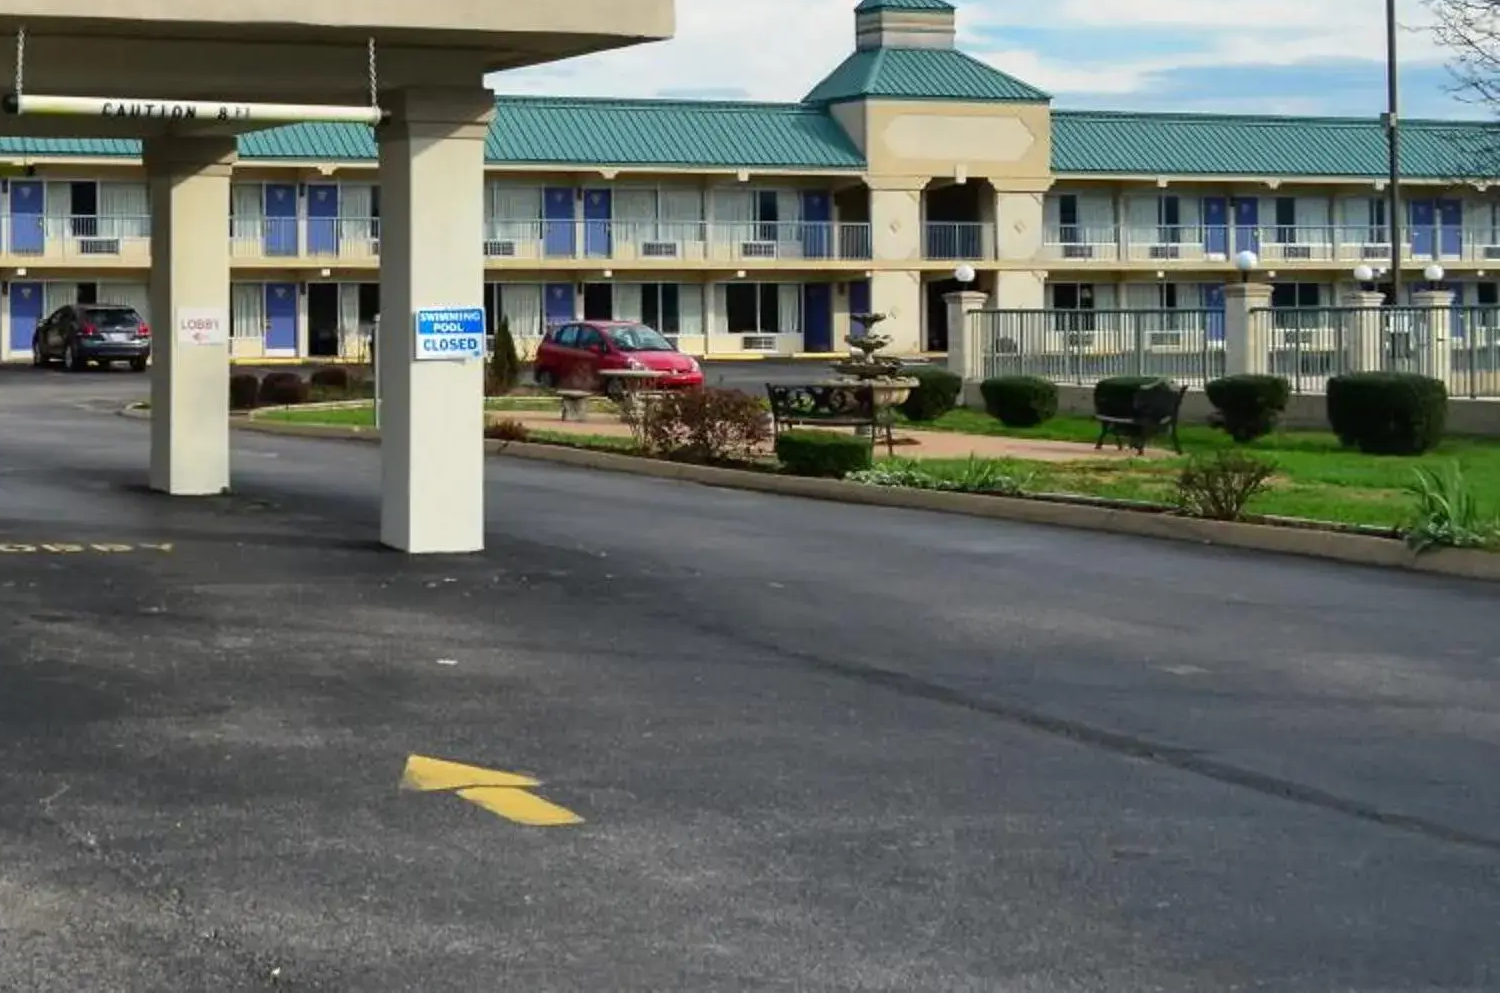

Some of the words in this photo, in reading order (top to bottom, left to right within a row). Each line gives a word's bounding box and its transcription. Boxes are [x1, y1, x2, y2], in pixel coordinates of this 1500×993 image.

[100, 102, 198, 119] CAUTION
[217, 103, 228, 120] 8
[420, 311, 481, 322] SWIMMING
[180, 318, 220, 330] LOBBY
[433, 322, 466, 332] POOL
[423, 338, 478, 352] CLOSED
